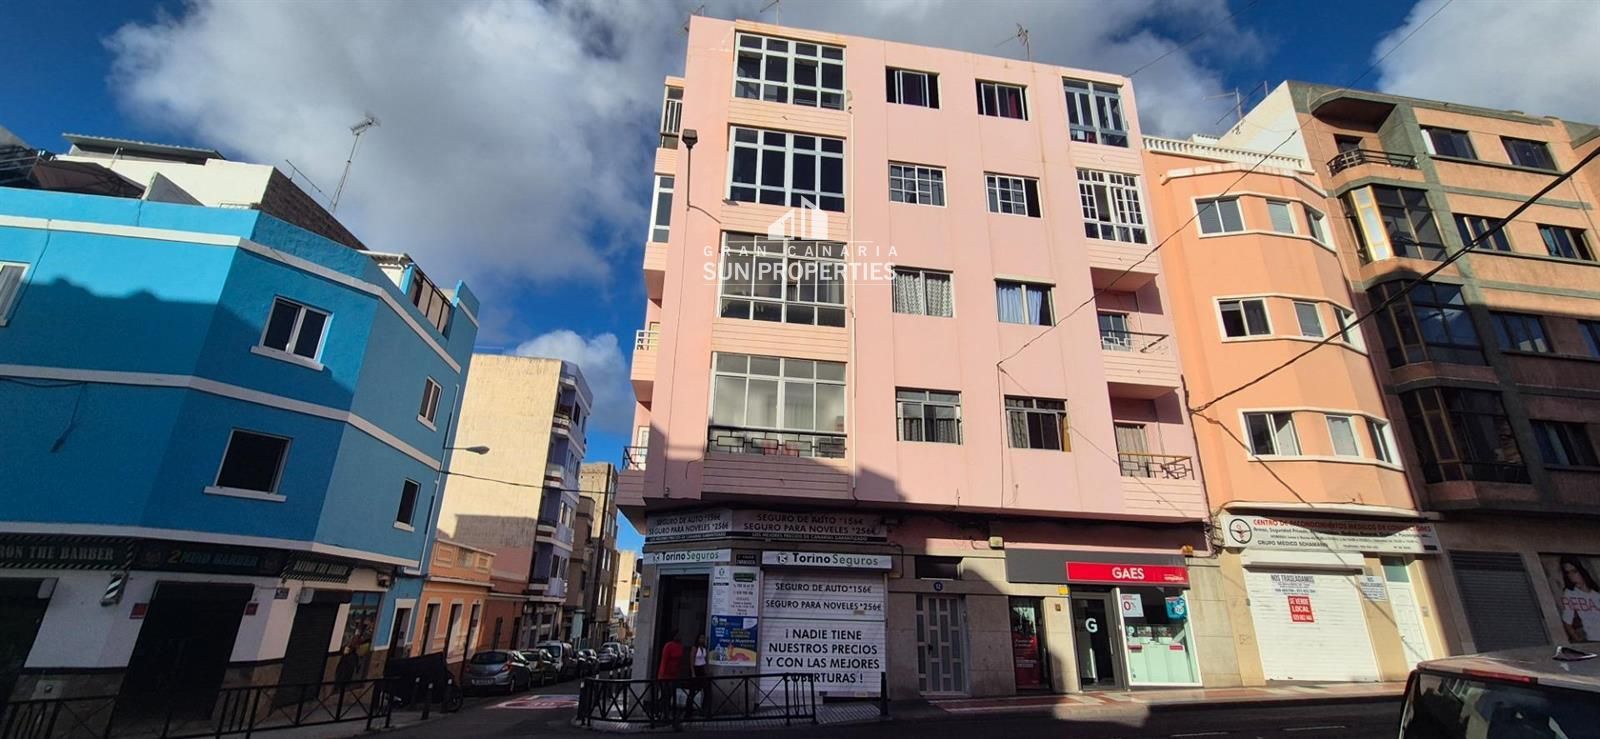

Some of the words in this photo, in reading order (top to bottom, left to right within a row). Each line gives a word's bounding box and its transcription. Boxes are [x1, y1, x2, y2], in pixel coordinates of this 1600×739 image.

[687, 515, 704, 523] AUTO
[757, 514, 794, 523] SEGURO
[797, 515, 808, 523] DE
[811, 515, 838, 524] AUTO
[1253, 518, 1278, 526] CENTRO
[686, 524, 710, 532] NOVELES
[744, 522, 781, 531] SEGURO
[783, 524, 807, 532] PARA
[809, 525, 849, 534] NOVELES
[29, 546, 55, 559] THE
[60, 547, 114, 560] BARBER
[1112, 567, 1145, 580] GAES
[775, 582, 810, 592] SEGURO
[812, 584, 823, 592] DE
[825, 584, 849, 592] AUTO
[766, 600, 799, 609] SEGURO
[801, 600, 821, 609] PARA
[823, 601, 859, 610] NOVELES
[1291, 605, 1310, 613] LOCAL
[1085, 617, 1098, 633] G
[792, 629, 828, 640] NADIE
[831, 630, 862, 640] TIENE
[768, 642, 828, 654] NUESTROS
[831, 644, 878, 655] PRECIOS
[766, 657, 773, 667] Y
[776, 657, 803, 668] CON
[807, 658, 827, 668] LAS
[830, 658, 880, 669] MEJORES
[860, 673, 863, 683] !
